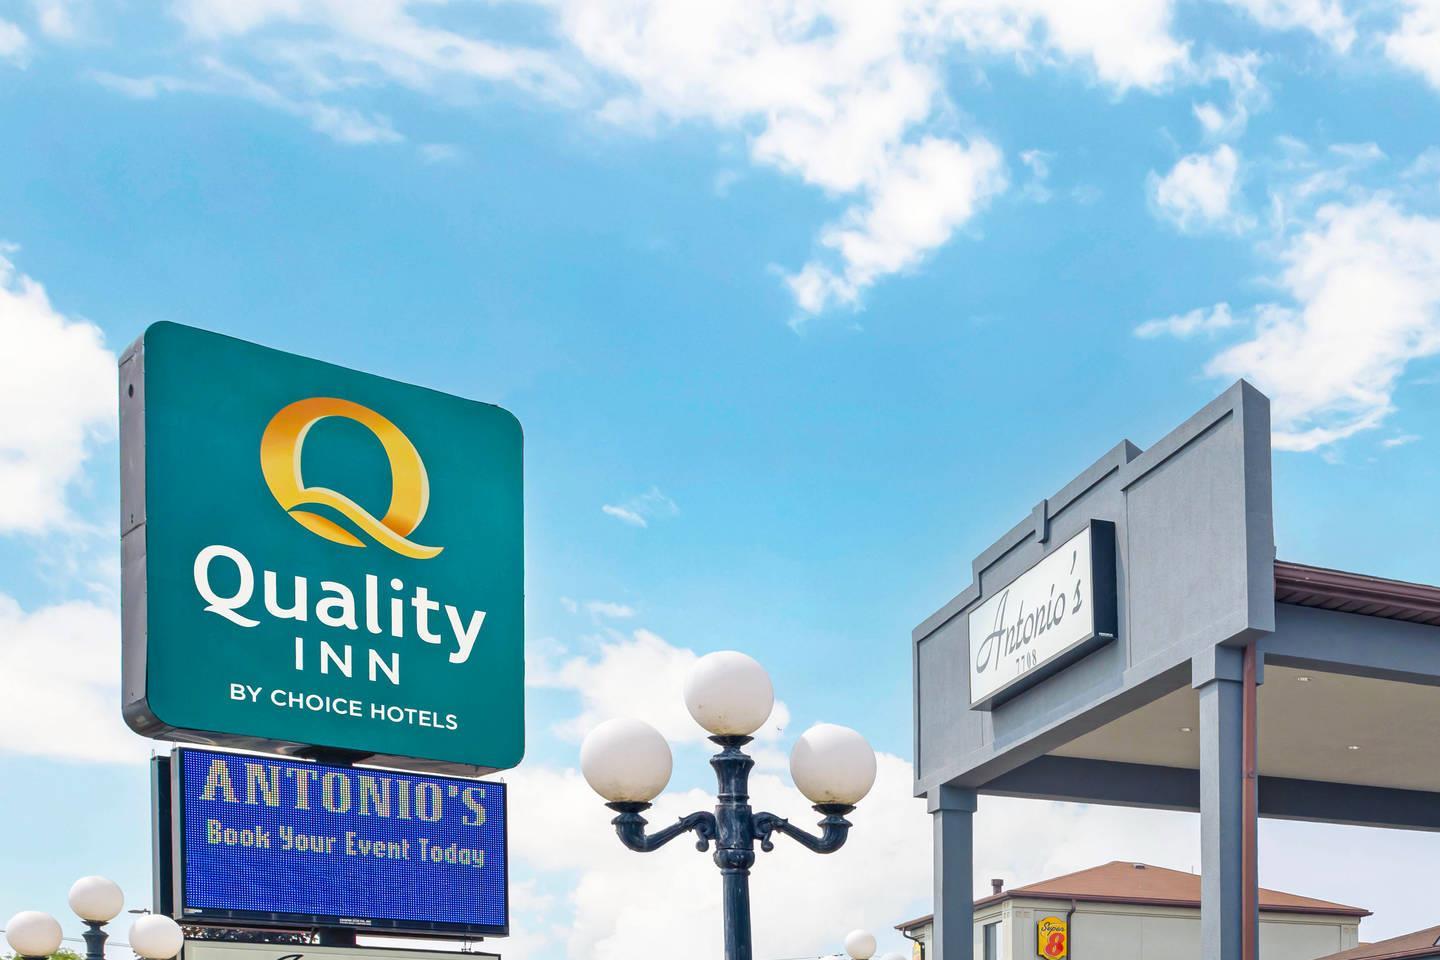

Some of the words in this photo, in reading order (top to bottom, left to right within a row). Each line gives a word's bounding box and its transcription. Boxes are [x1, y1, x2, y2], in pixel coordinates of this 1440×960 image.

[260, 397, 444, 559] Q
[193, 544, 487, 664] Quality
[976, 550, 1083, 674] Antonio's
[295, 637, 400, 685] INN
[230, 683, 262, 702] BY
[270, 688, 363, 718] CHOICE
[370, 703, 458, 730] HOTELS
[198, 759, 487, 827] ANTONIO'S
[207, 819, 270, 849] Book
[278, 825, 337, 855] Your
[345, 831, 411, 860] Event
[418, 837, 486, 868] Today
[1041, 922, 1064, 936] Super
[1045, 933, 1065, 956] 8
